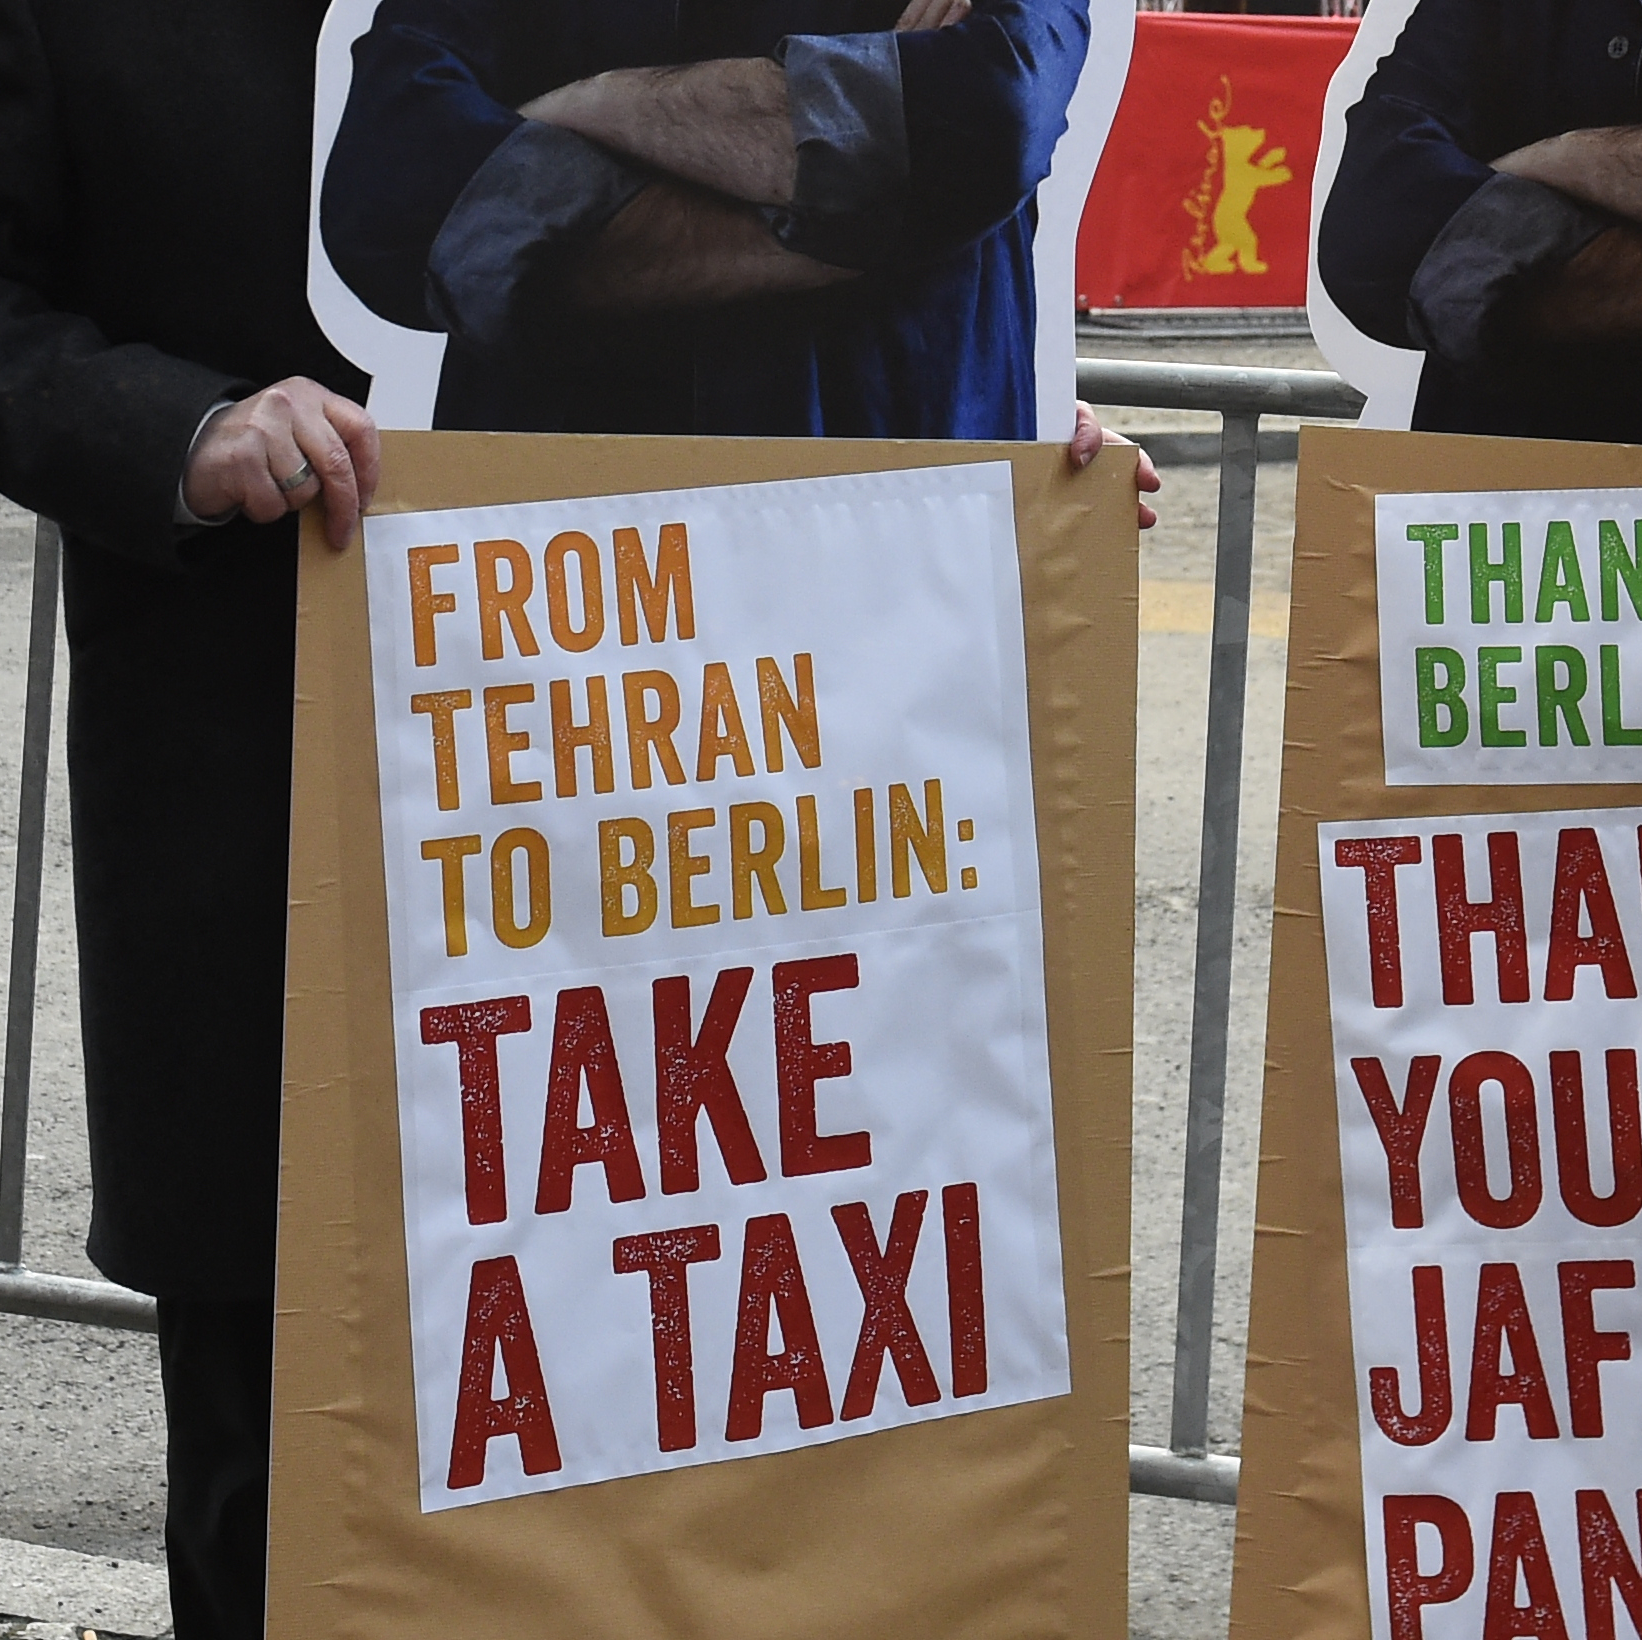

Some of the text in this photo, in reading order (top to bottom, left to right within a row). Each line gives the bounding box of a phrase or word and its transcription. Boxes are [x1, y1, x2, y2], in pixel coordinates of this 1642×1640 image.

[409, 523, 695, 667] FROM
[411, 653, 821, 810] TEHRAN
[422, 779, 978, 957] TO BERLIN:
[420, 953, 872, 1226] TAKE
[447, 1182, 989, 1490] A TAXI
